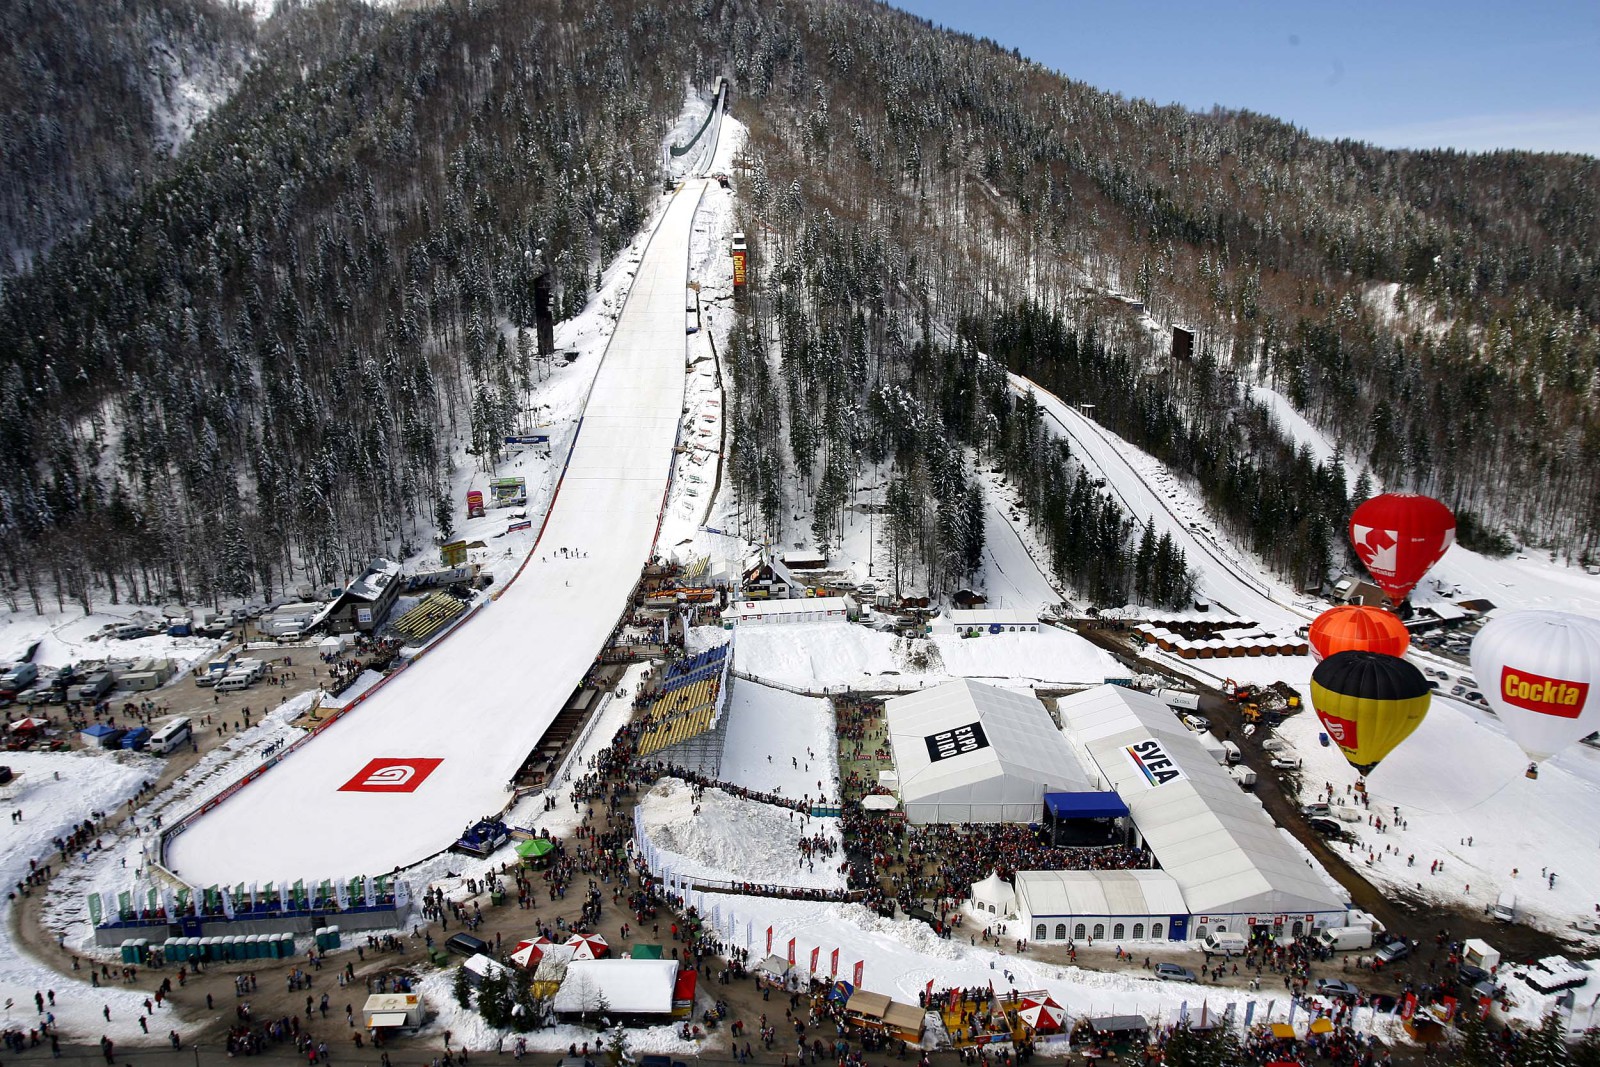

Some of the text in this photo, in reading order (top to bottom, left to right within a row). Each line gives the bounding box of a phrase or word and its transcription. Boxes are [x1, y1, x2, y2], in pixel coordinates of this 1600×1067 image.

[1505, 674, 1580, 705] Cockta
[934, 732, 958, 758] BIRO
[954, 726, 978, 752] EXPO
[1133, 741, 1180, 785] SVEA
